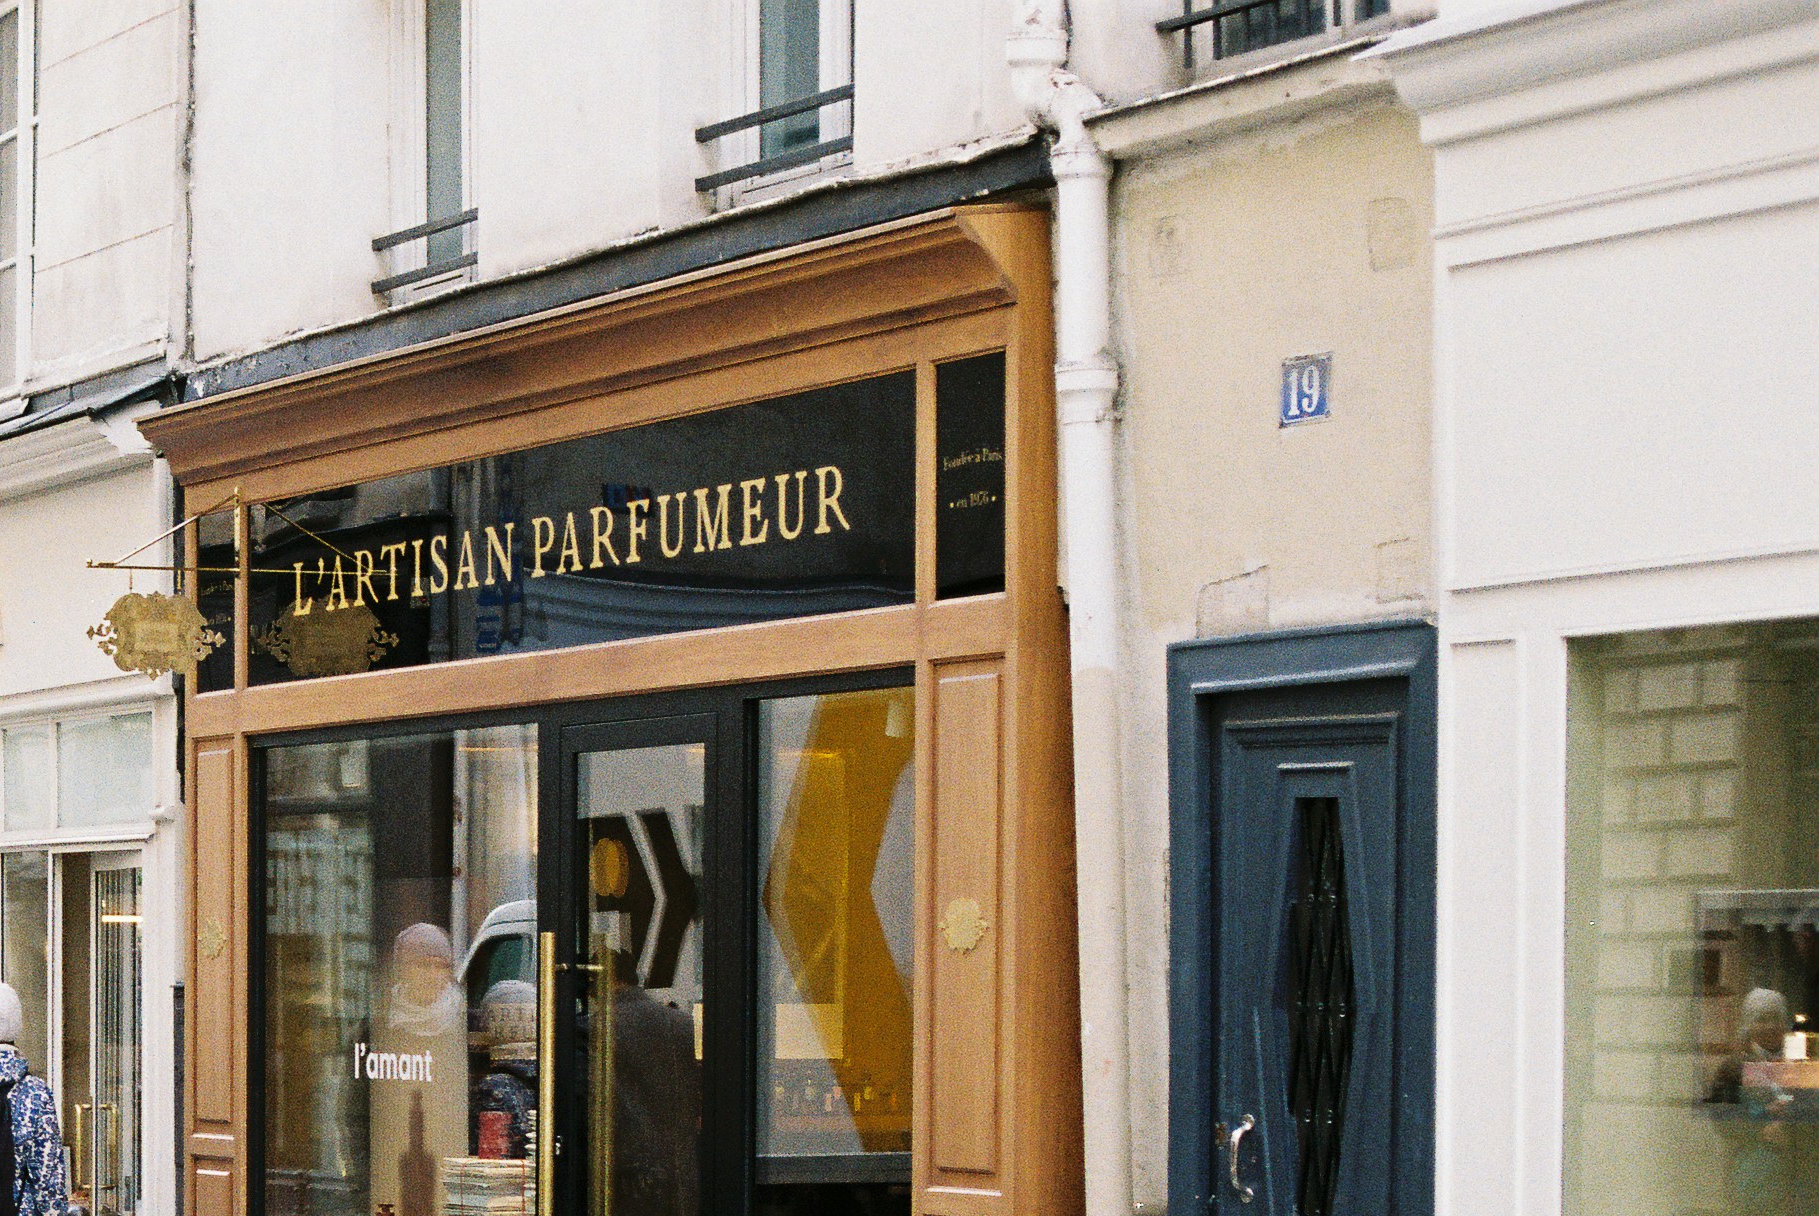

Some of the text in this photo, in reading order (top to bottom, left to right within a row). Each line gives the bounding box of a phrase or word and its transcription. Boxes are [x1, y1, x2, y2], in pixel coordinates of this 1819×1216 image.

[1288, 366, 1320, 415] 19
[293, 465, 851, 616] L'ARTISAN PARFUMEUR
[354, 1042, 432, 1082] l'amant
